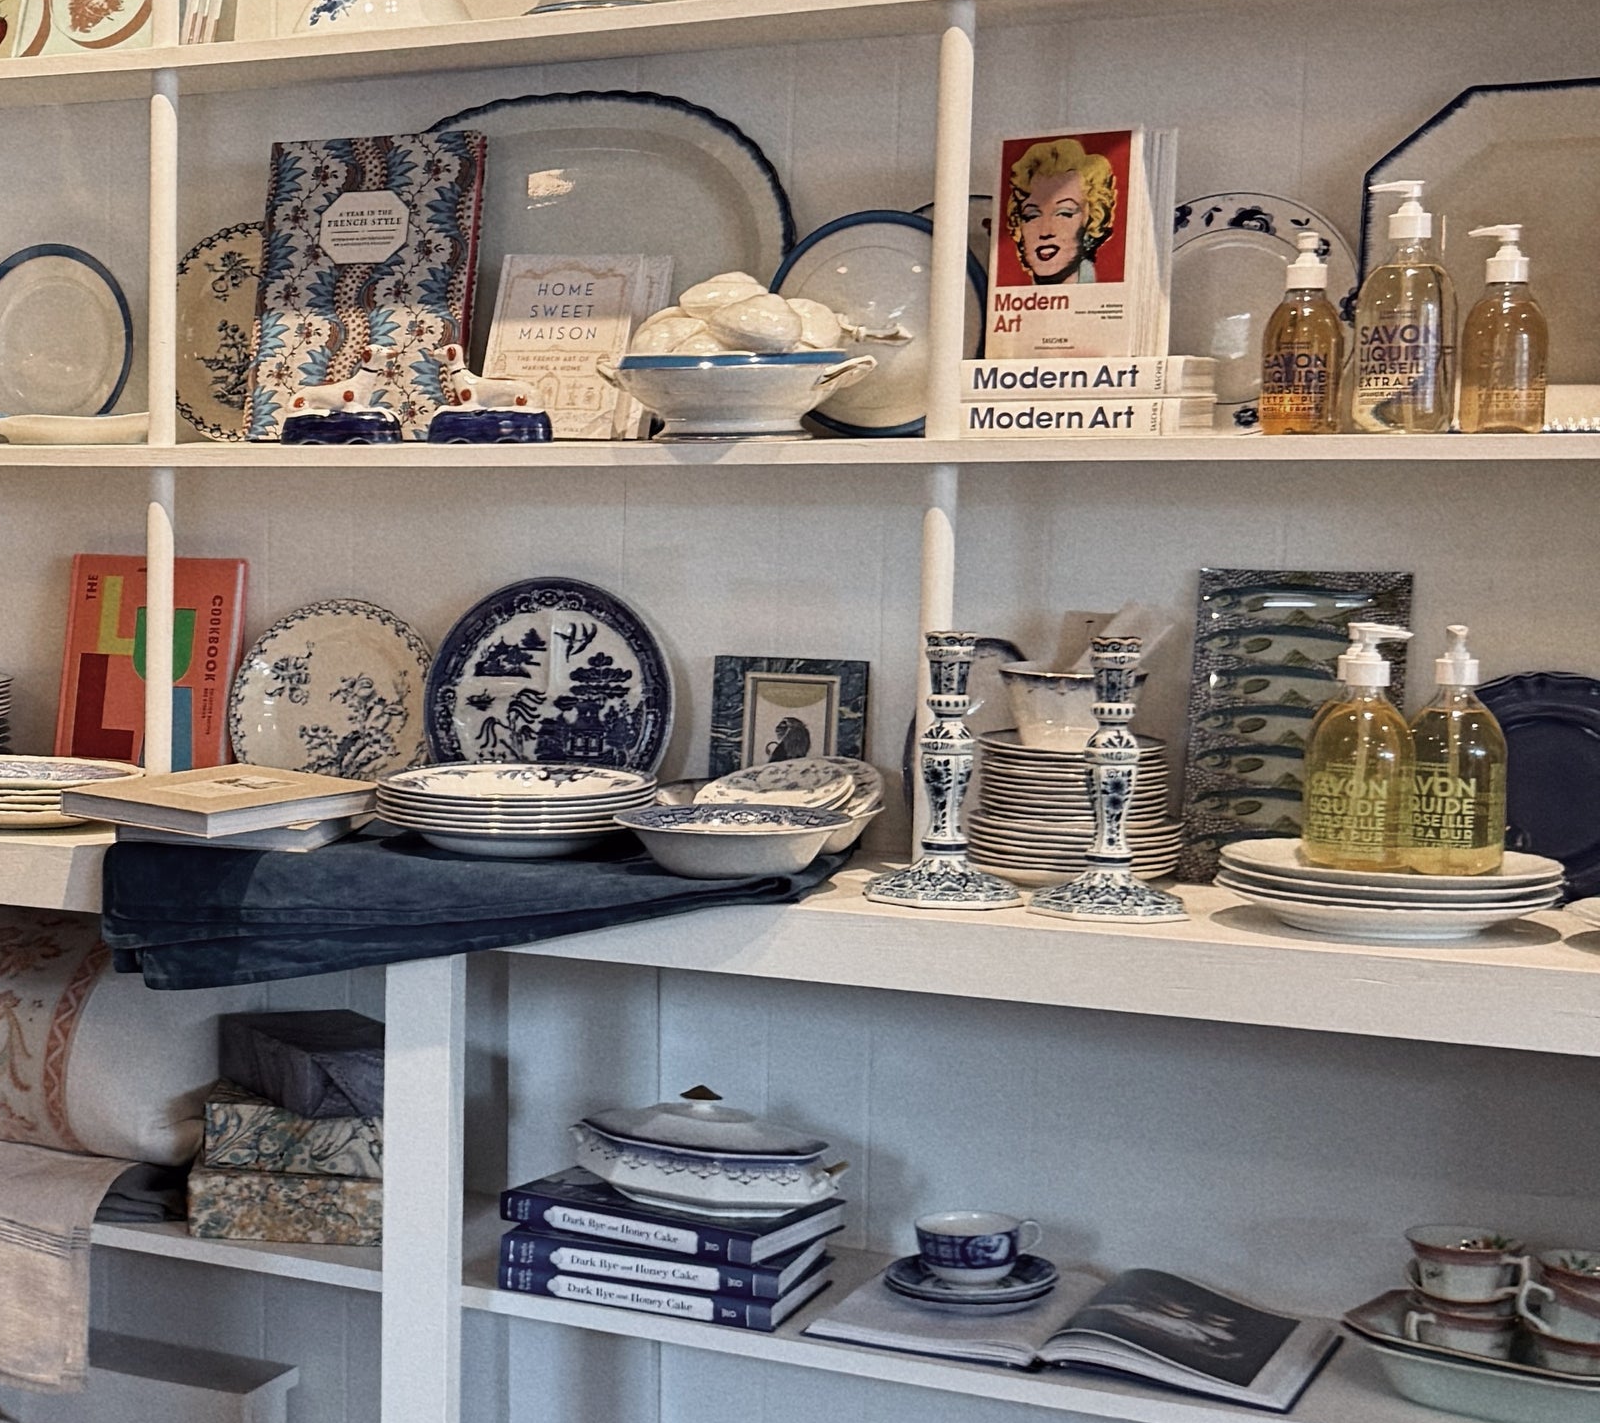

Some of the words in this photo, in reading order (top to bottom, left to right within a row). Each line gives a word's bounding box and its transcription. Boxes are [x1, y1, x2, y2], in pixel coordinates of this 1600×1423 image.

[327, 218, 368, 228] FRENCH
[372, 217, 403, 226] STYLE
[537, 282, 595, 296] HOME
[529, 304, 595, 319] SWEET
[994, 292, 1069, 312] Modern
[518, 326, 598, 340] MAISON
[993, 314, 1022, 333] Art
[1360, 324, 1440, 346] SAVON
[1264, 352, 1328, 369] SAVON
[1359, 361, 1436, 376] MARSEIL
[973, 365, 1088, 390] Modern
[1092, 364, 1140, 389] Art
[1153, 360, 1163, 391] TASCHEN
[1359, 376, 1402, 388] EXTRA
[969, 406, 1084, 429] Modern
[1087, 405, 1135, 429] Art
[85, 574, 98, 600] THE
[204, 595, 224, 682] COOKBOOK
[1408, 775, 1477, 797] AVON
[1406, 795, 1476, 815] QUIDE
[1411, 813, 1475, 829] RSEILLE
[1440, 828, 1474, 840] PUR
[562, 1212, 585, 1227] Dark
[588, 1218, 606, 1230] Rye
[621, 1224, 652, 1240] Honey
[654, 1231, 679, 1243] Cake
[570, 1254, 597, 1268] Dark
[600, 1259, 619, 1271] Rye
[635, 1263, 669, 1279] Honey
[671, 1268, 699, 1281] Cake
[567, 1282, 592, 1296] Dark
[596, 1286, 615, 1299] Rye
[631, 1293, 665, 1308] Honey
[666, 1298, 693, 1311] Cake
